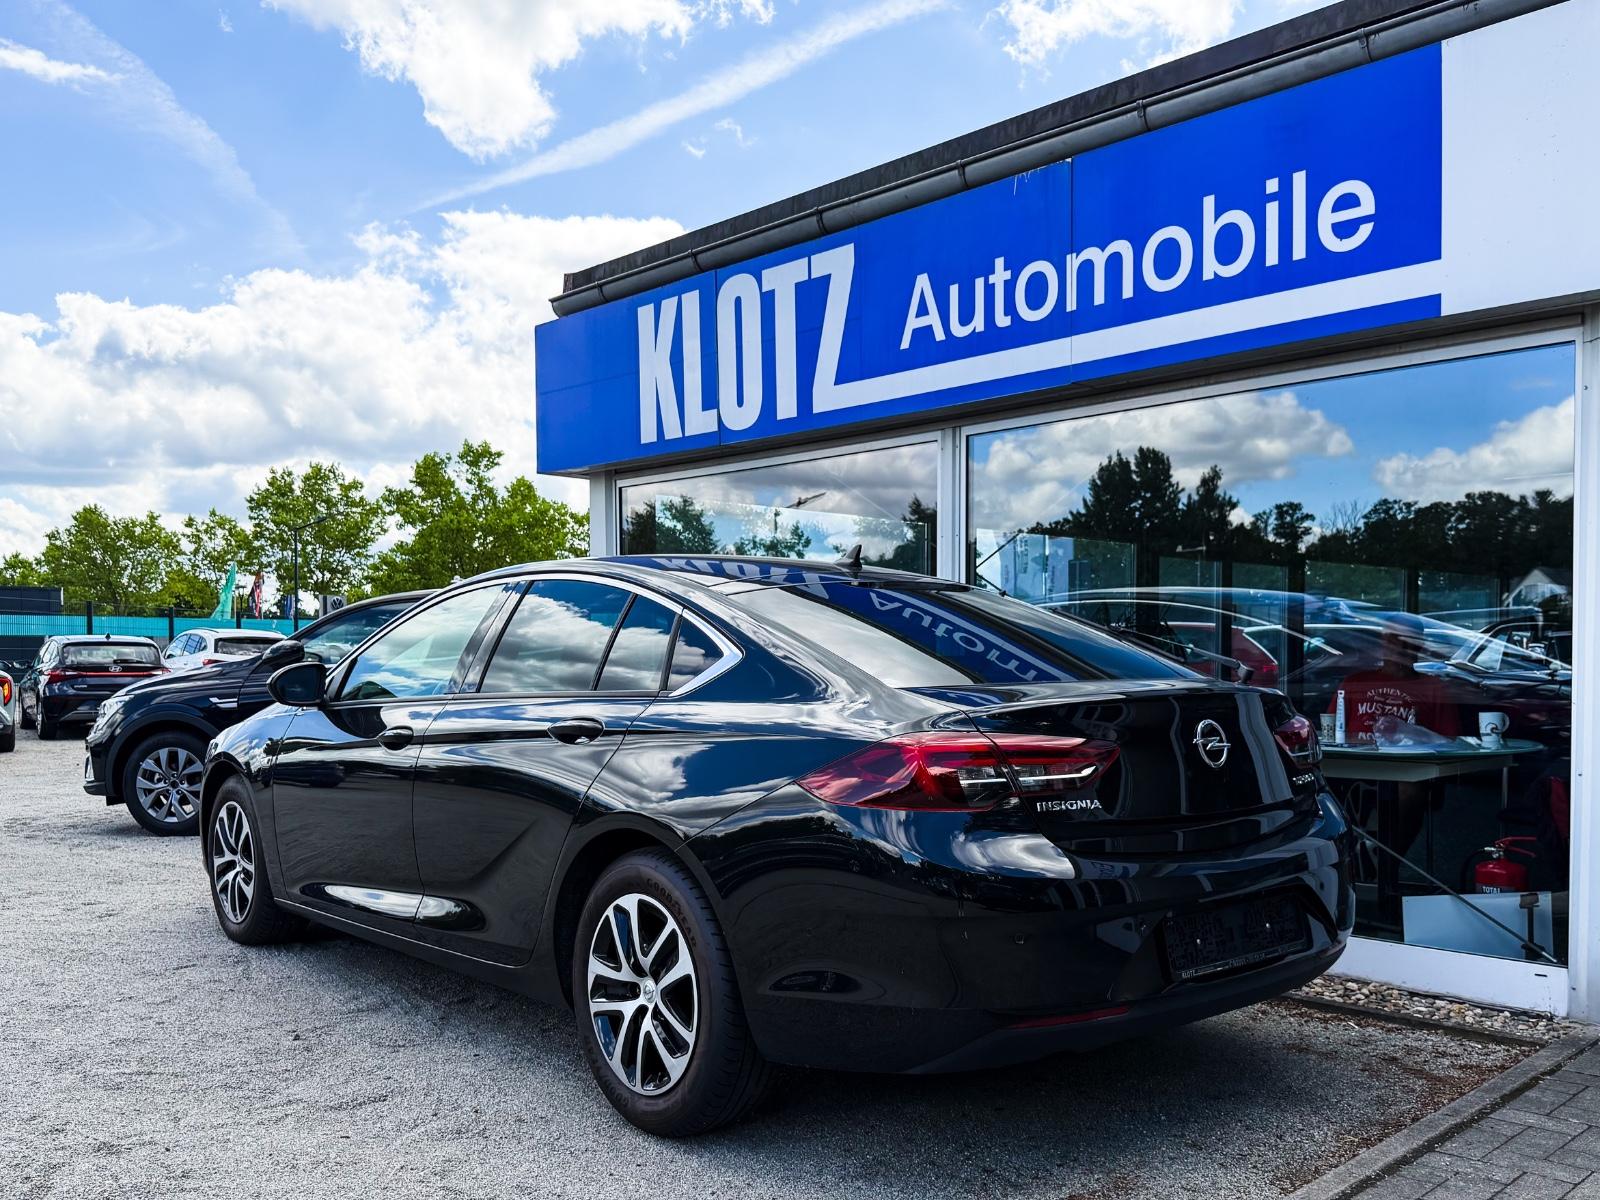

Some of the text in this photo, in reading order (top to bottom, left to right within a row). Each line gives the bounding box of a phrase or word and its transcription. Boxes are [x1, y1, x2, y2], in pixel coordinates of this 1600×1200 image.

[638, 170, 1377, 444] KLOTZ Automobile
[1036, 799, 1103, 812] INSIGNIA
